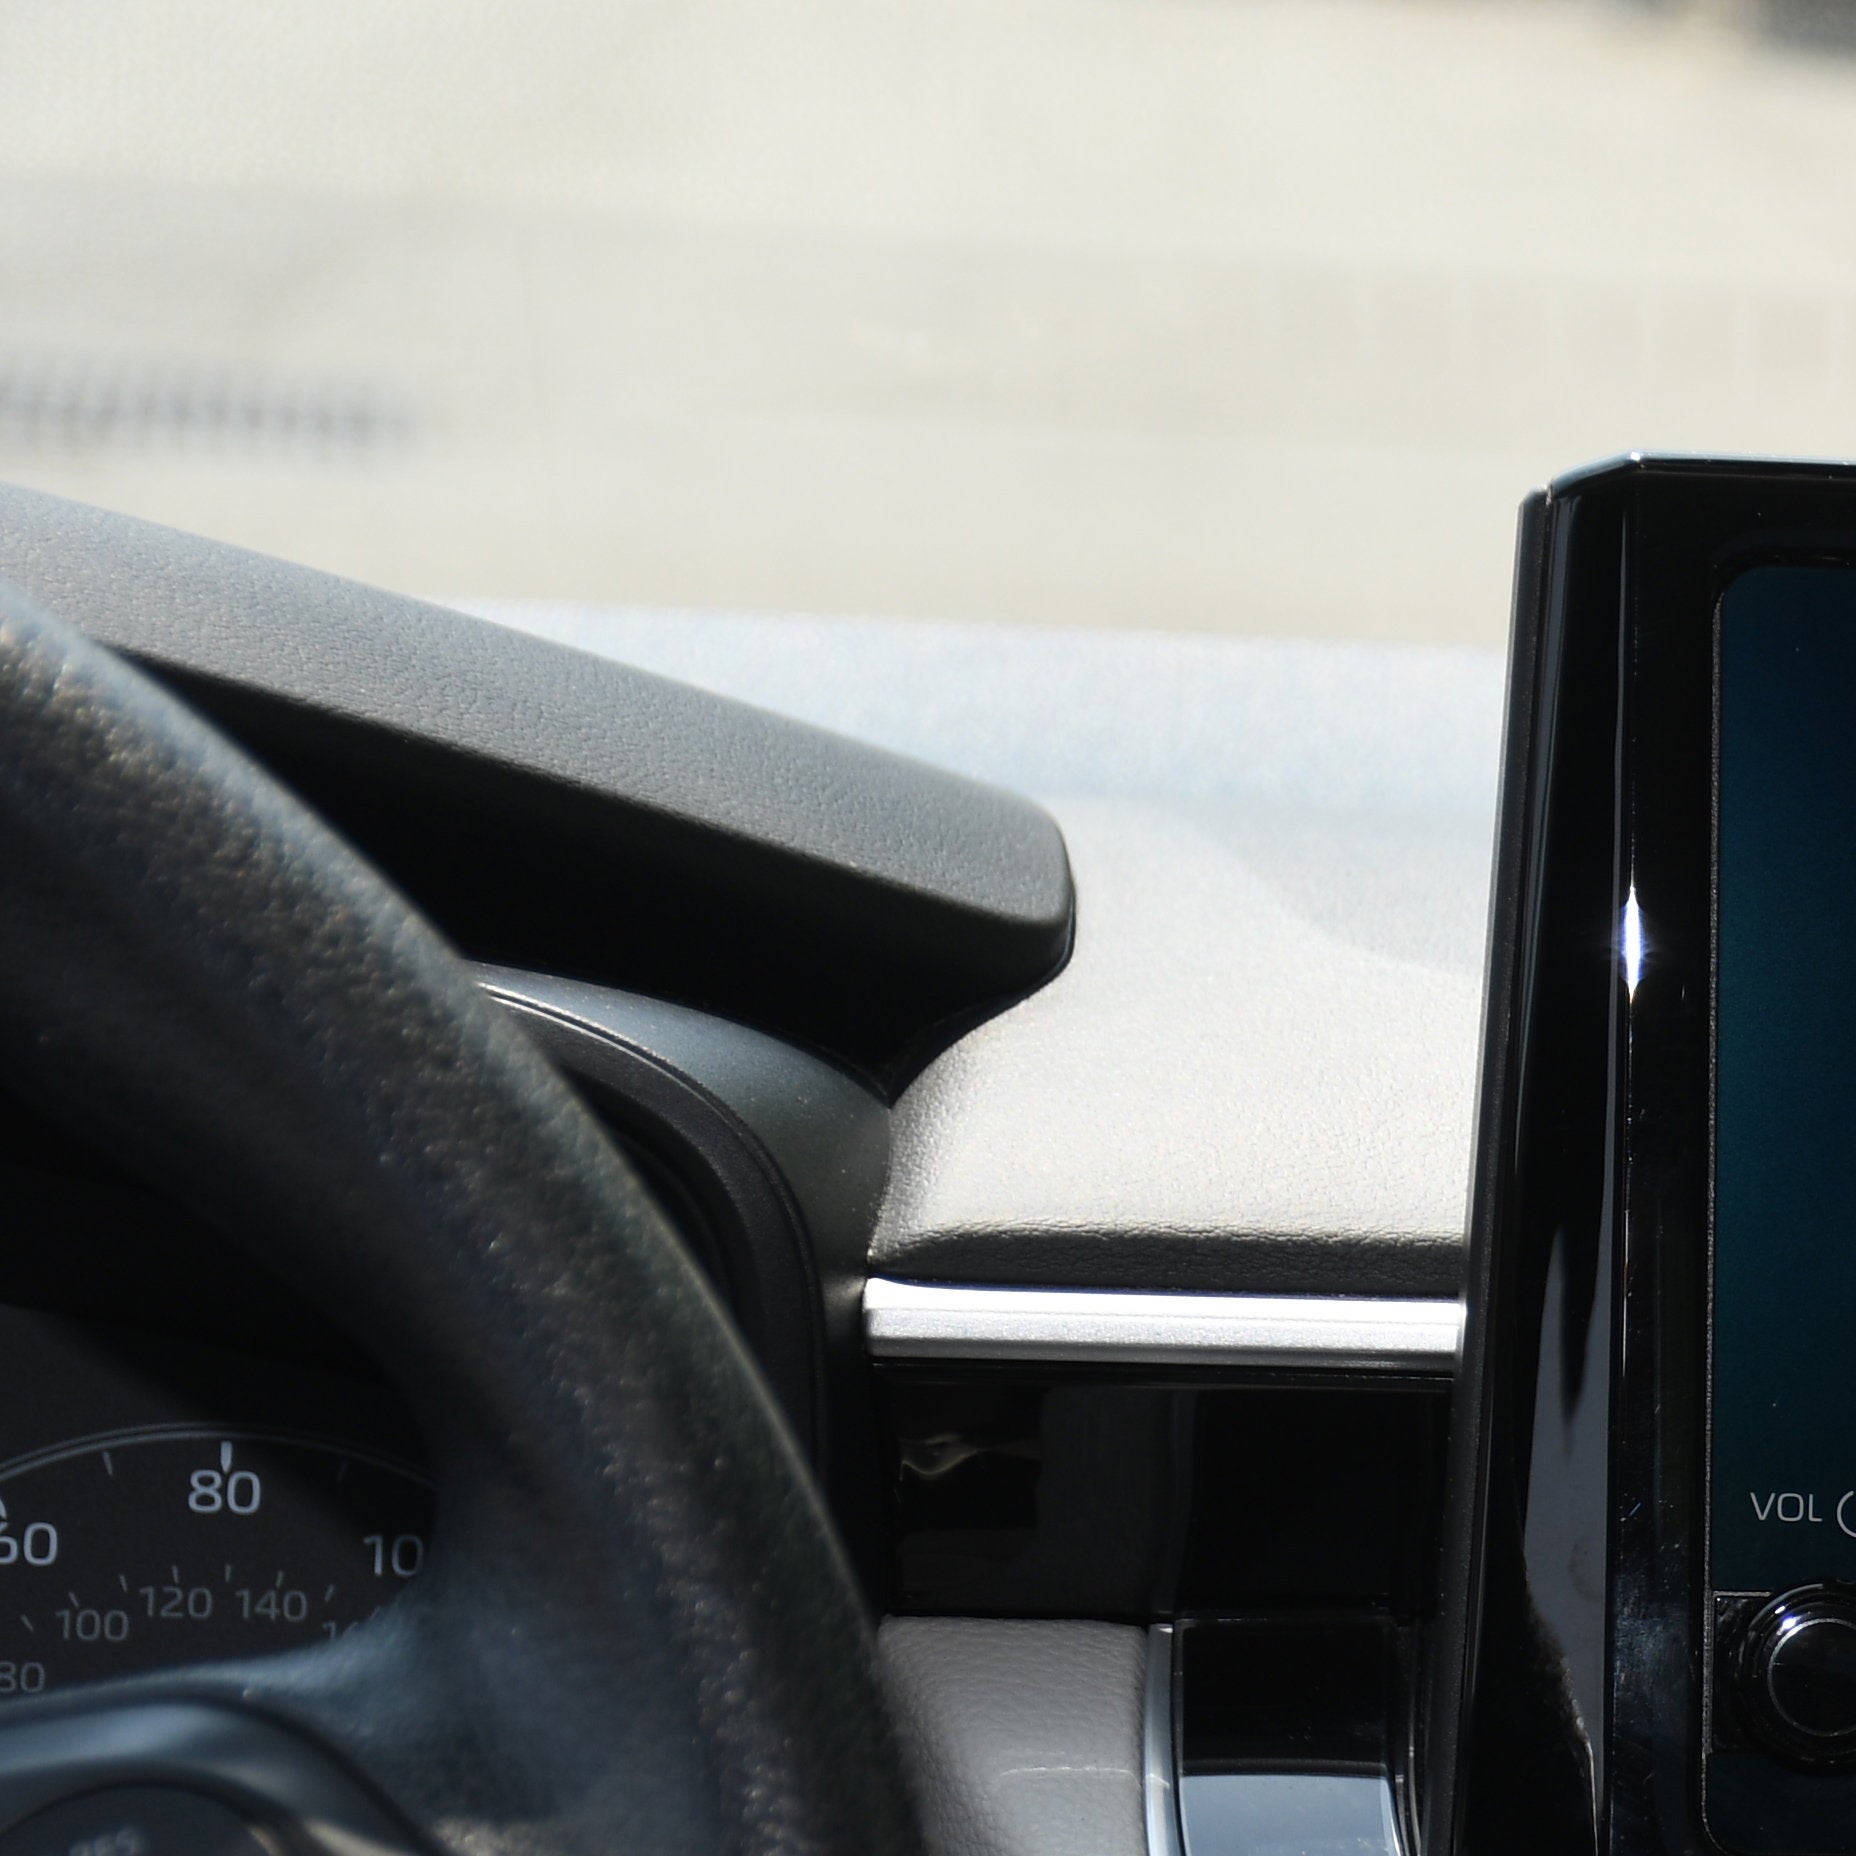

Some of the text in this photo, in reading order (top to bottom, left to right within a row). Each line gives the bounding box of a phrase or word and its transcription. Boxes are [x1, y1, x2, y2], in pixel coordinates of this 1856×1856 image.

[187, 1470, 260, 1515] 80
[1750, 1492, 1823, 1522] VOL
[363, 1534, 424, 1577] 10
[139, 1587, 213, 1620] 120
[235, 1589, 307, 1622] 140
[55, 1609, 128, 1642] 100
